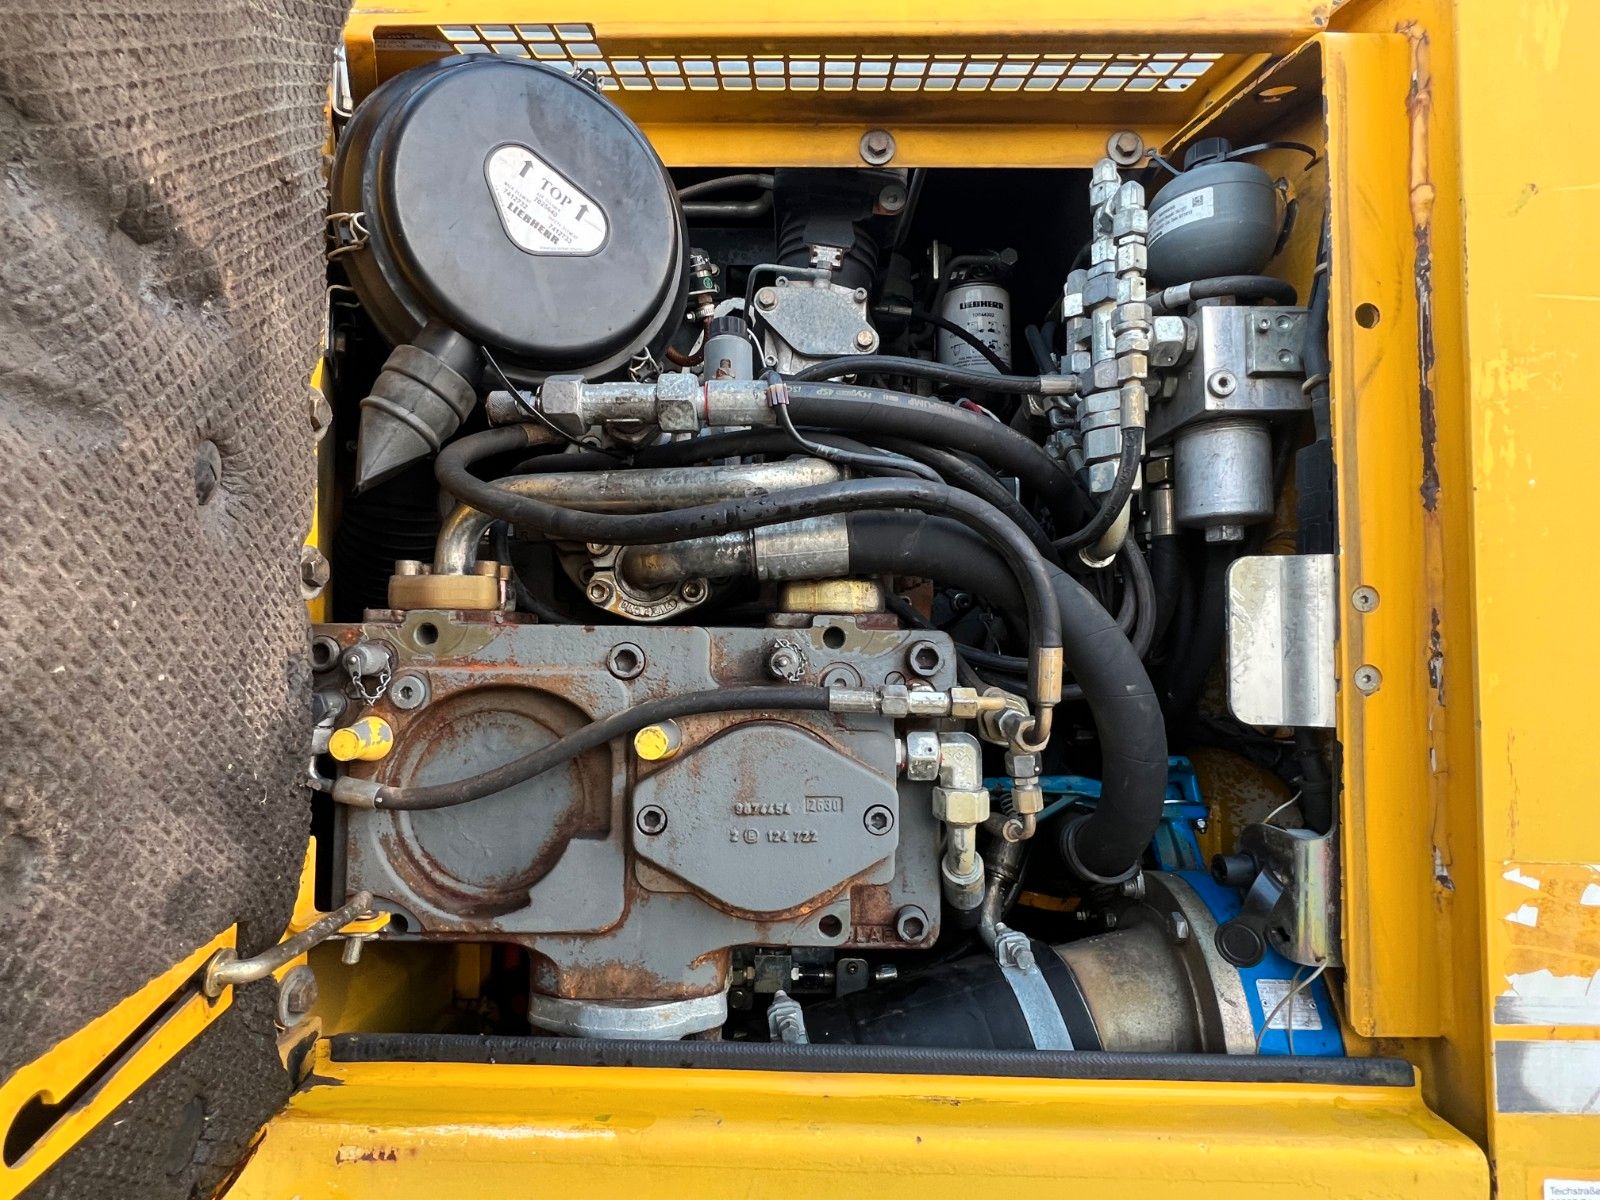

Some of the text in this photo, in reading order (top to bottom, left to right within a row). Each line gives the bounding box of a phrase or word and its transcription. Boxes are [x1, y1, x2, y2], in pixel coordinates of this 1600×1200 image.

[541, 177, 573, 206] TOP
[506, 201, 560, 245] LIEBHERR
[960, 300, 1004, 310] LIEBHERR
